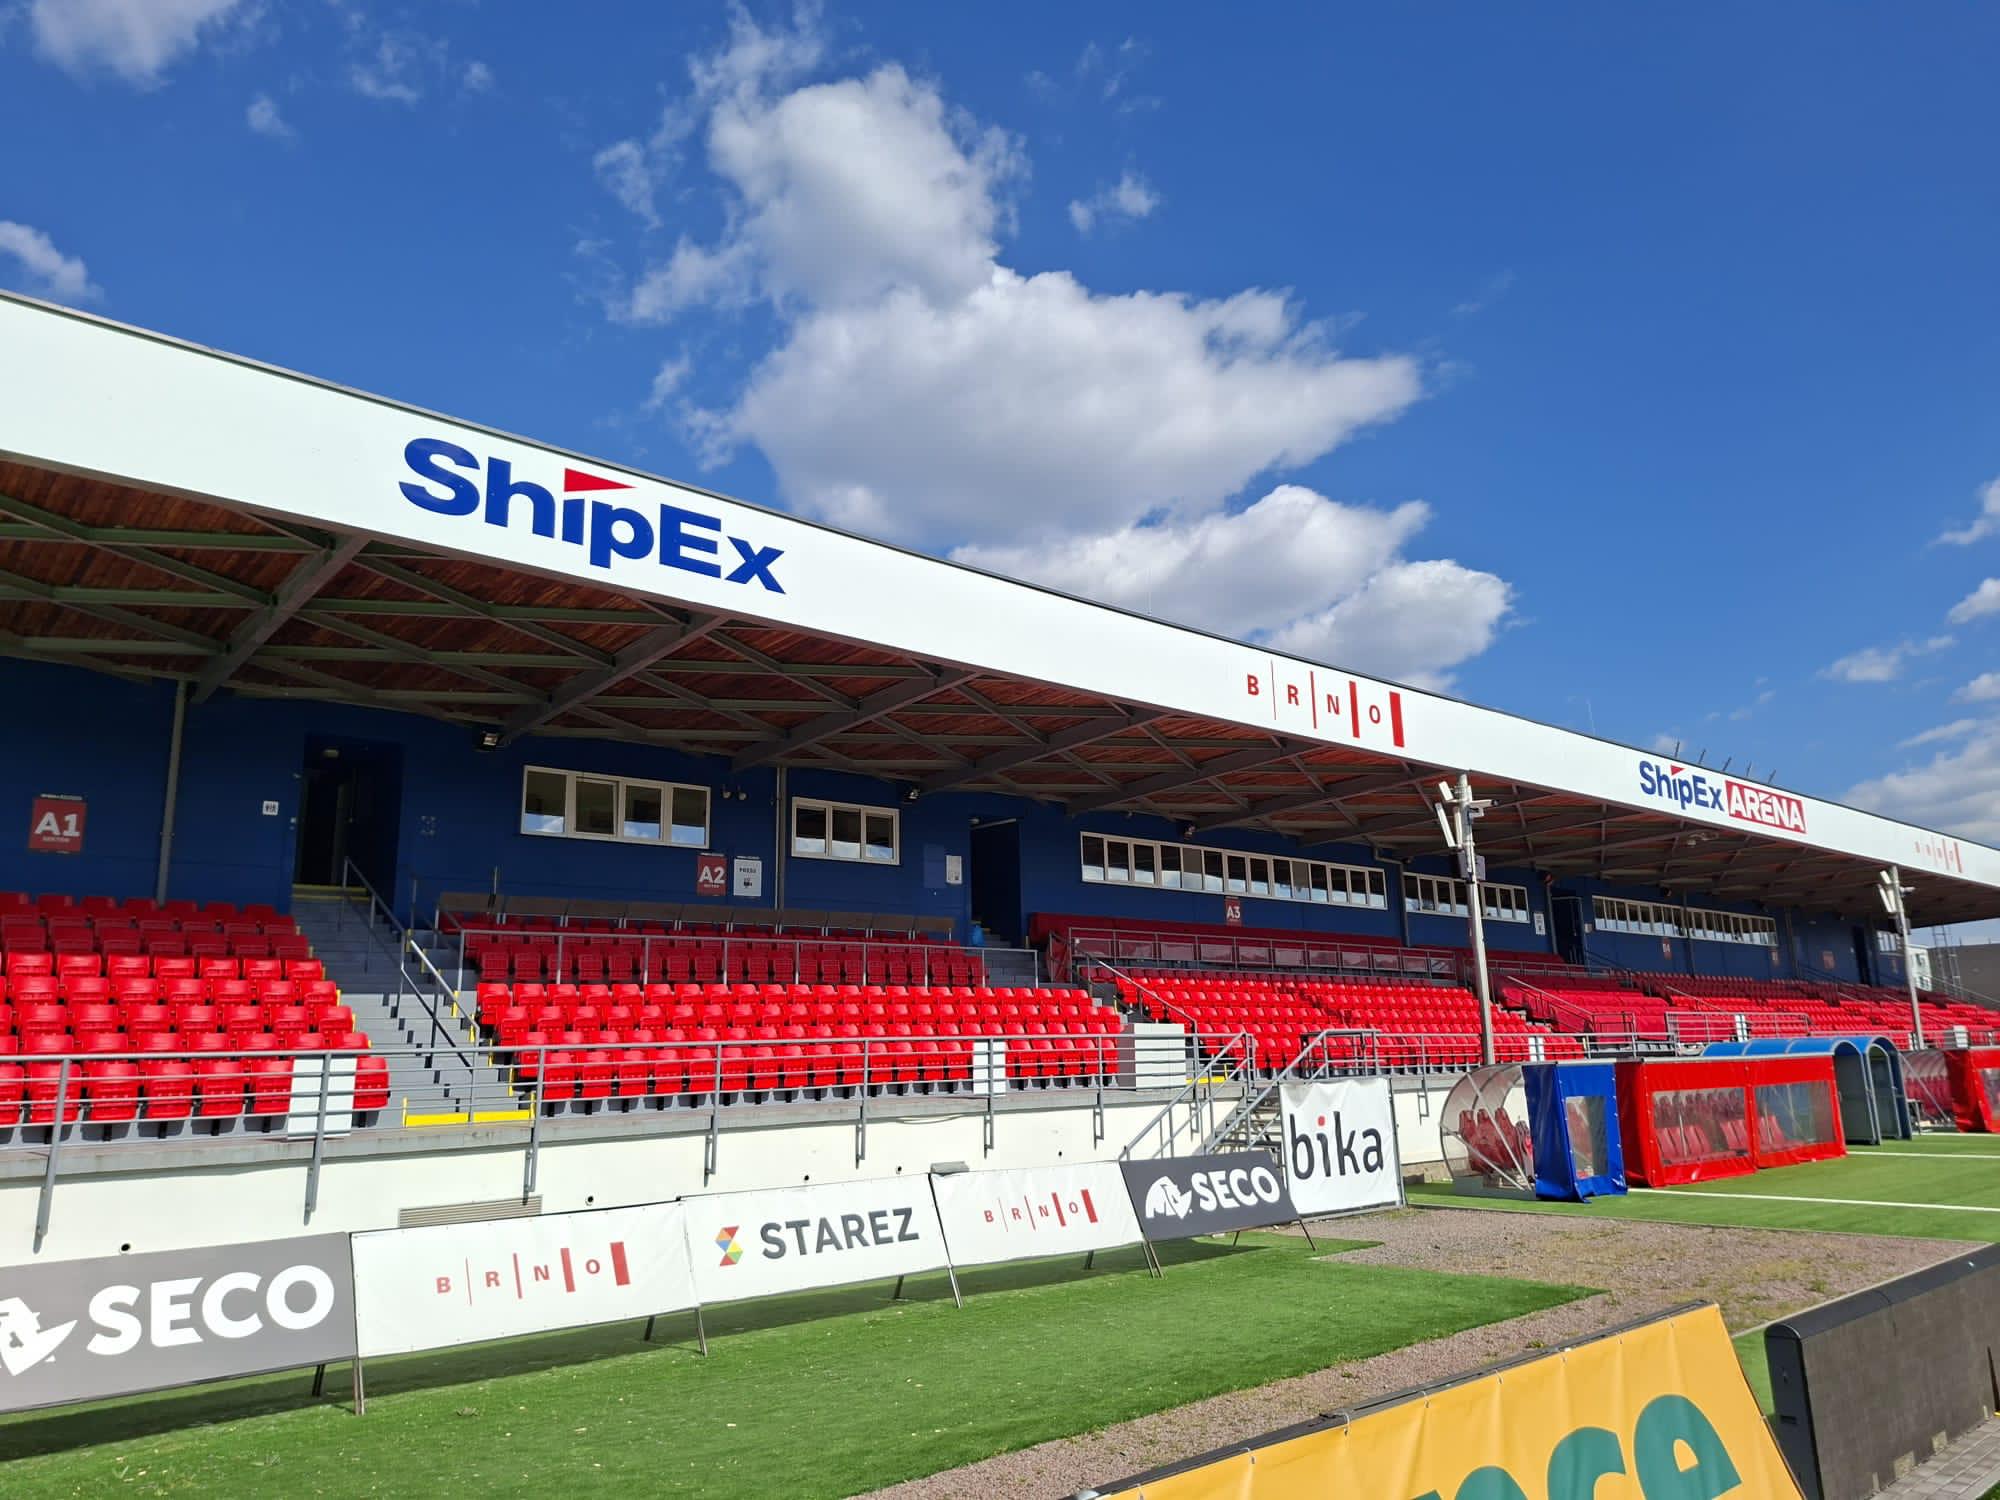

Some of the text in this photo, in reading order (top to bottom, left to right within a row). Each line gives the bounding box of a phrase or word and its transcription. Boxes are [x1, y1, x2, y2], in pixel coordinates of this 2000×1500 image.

[398, 437, 787, 595] ShipEx
[1639, 760, 1725, 812] ShipEx
[34, 811, 81, 837] A1
[699, 865, 726, 884] A2
[1226, 904, 1241, 919] A3
[1289, 1110, 1384, 1180] bika
[1191, 1166, 1281, 1212] SECO
[759, 1206, 920, 1260] STAREZ
[86, 1264, 335, 1356] SECO
